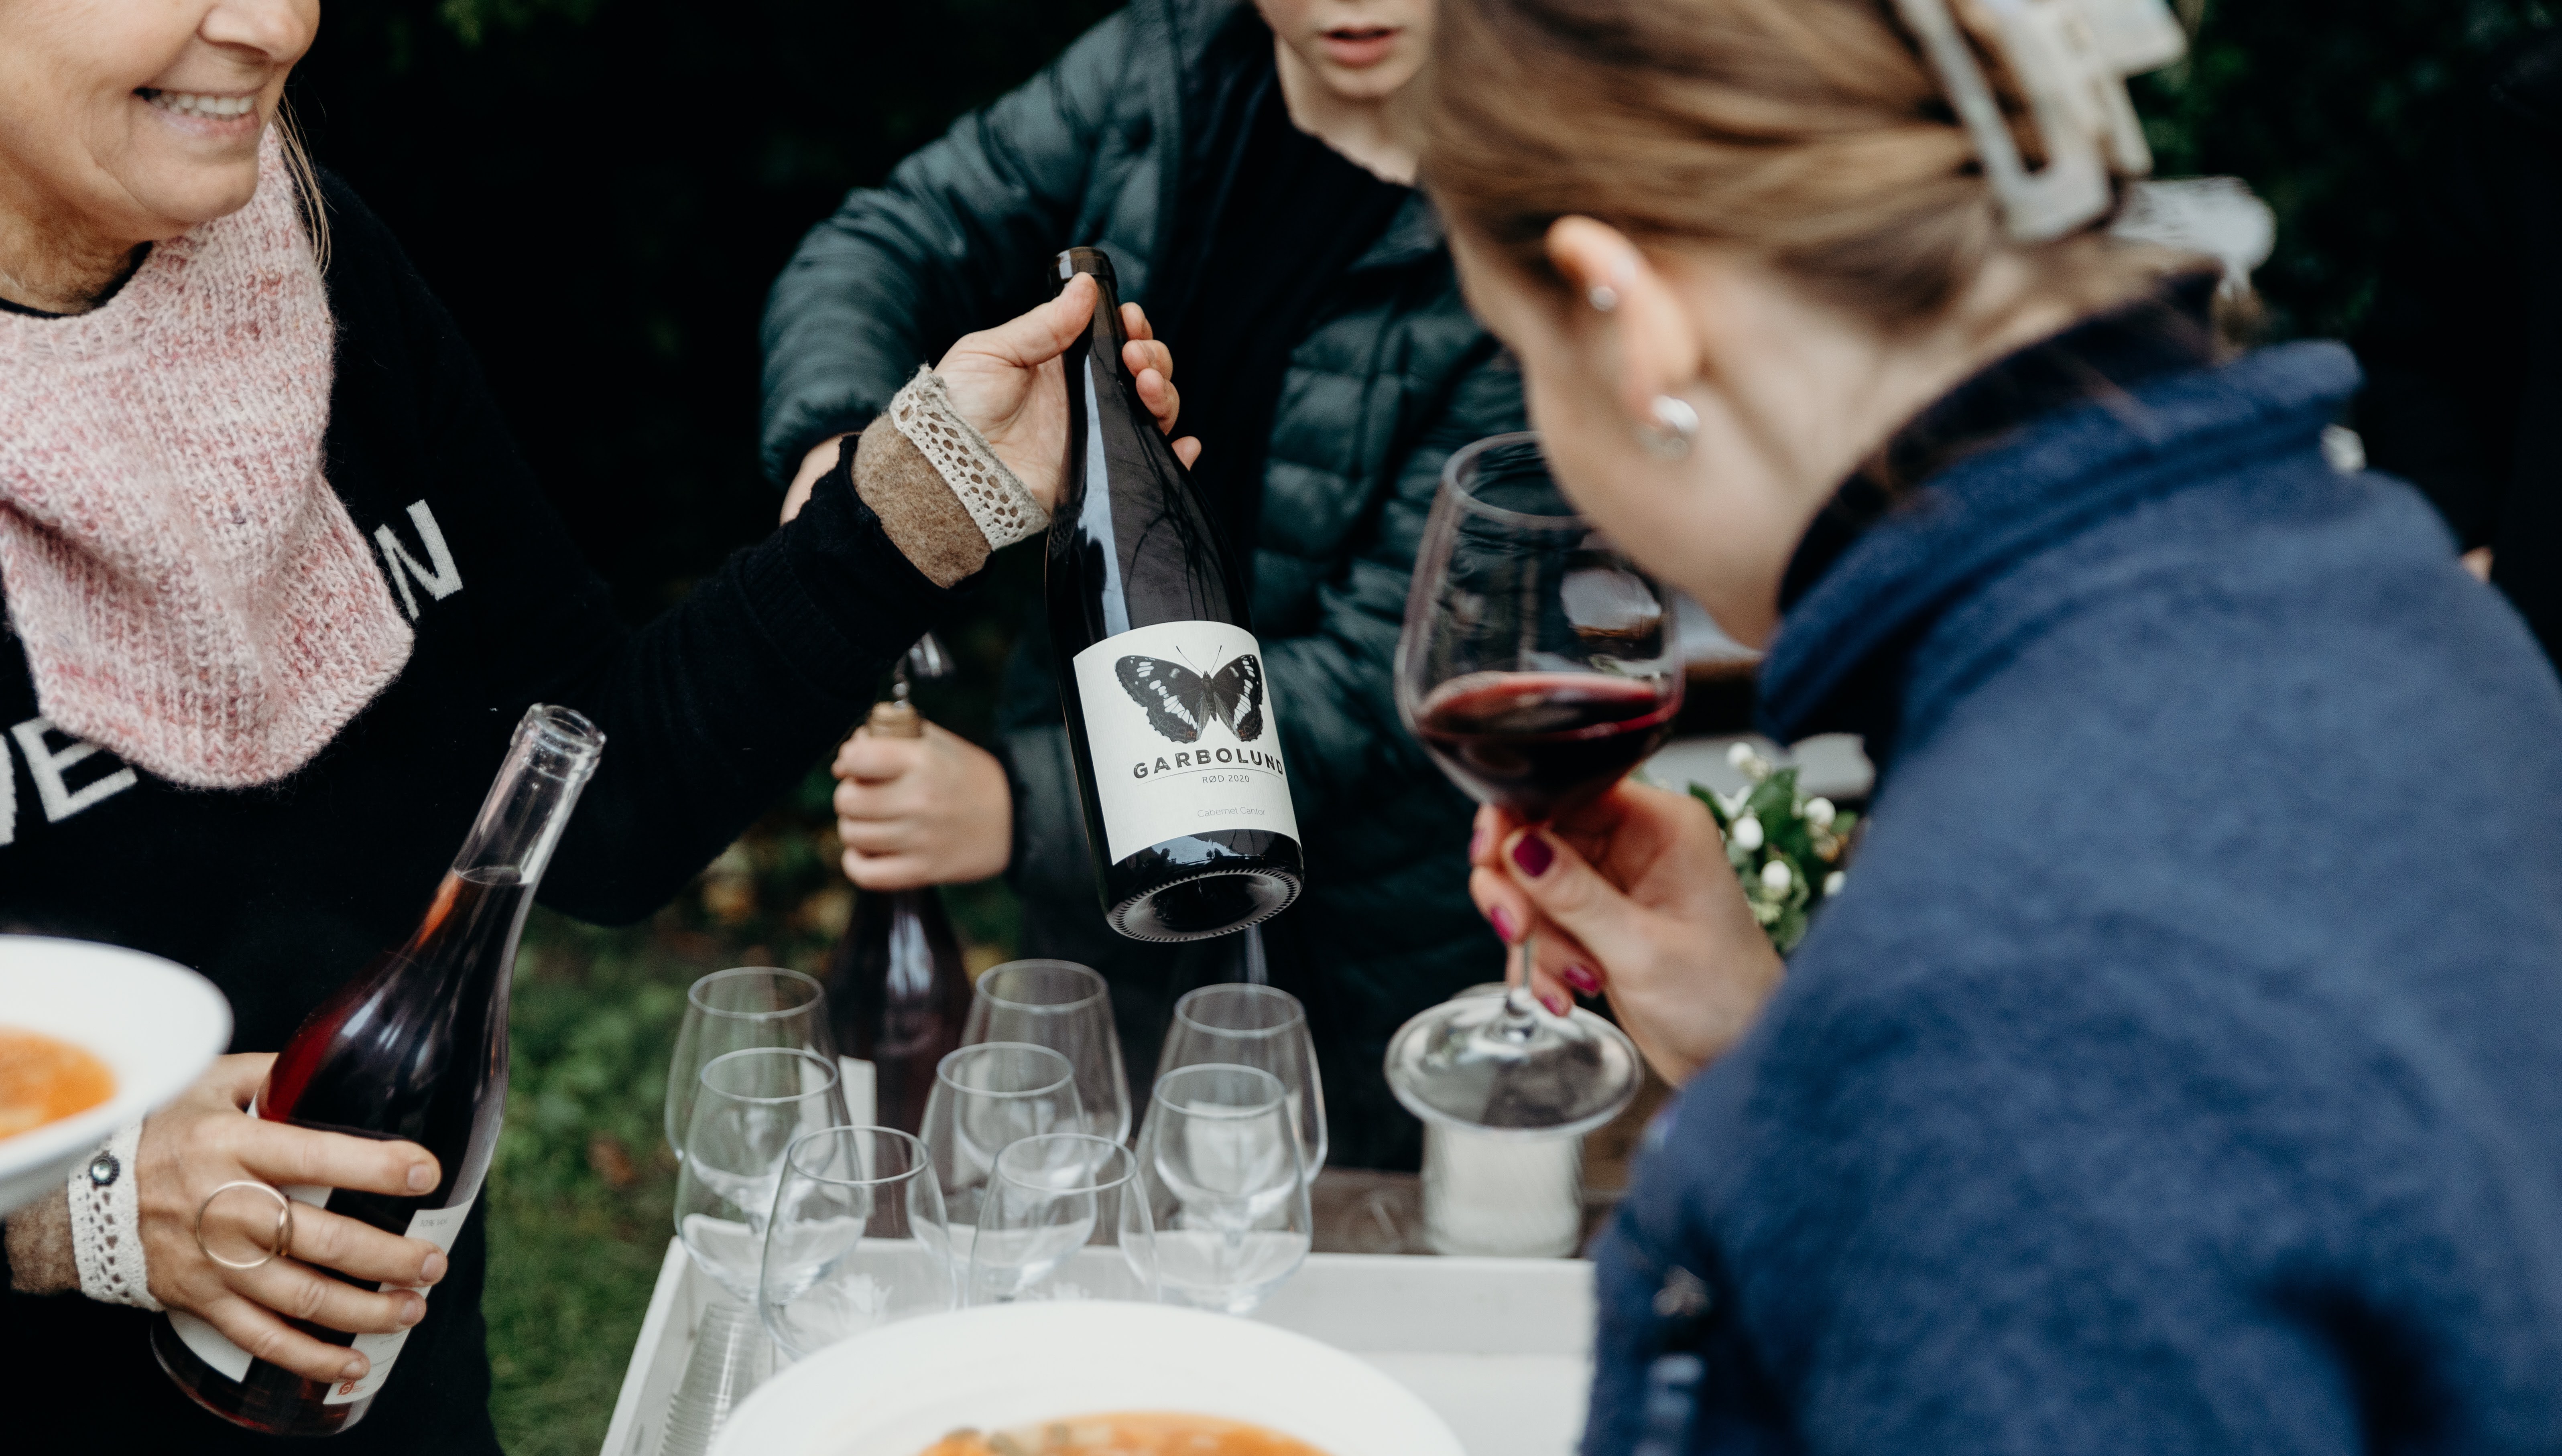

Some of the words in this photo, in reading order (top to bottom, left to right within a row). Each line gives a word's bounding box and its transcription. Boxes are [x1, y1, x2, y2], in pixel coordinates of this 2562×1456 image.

[1133, 747, 1283, 779] GARBOLUND
[1202, 775, 1224, 784] RØD
[1198, 807, 1238, 817] Cabernet
[1240, 806, 1265, 815] Cantor
